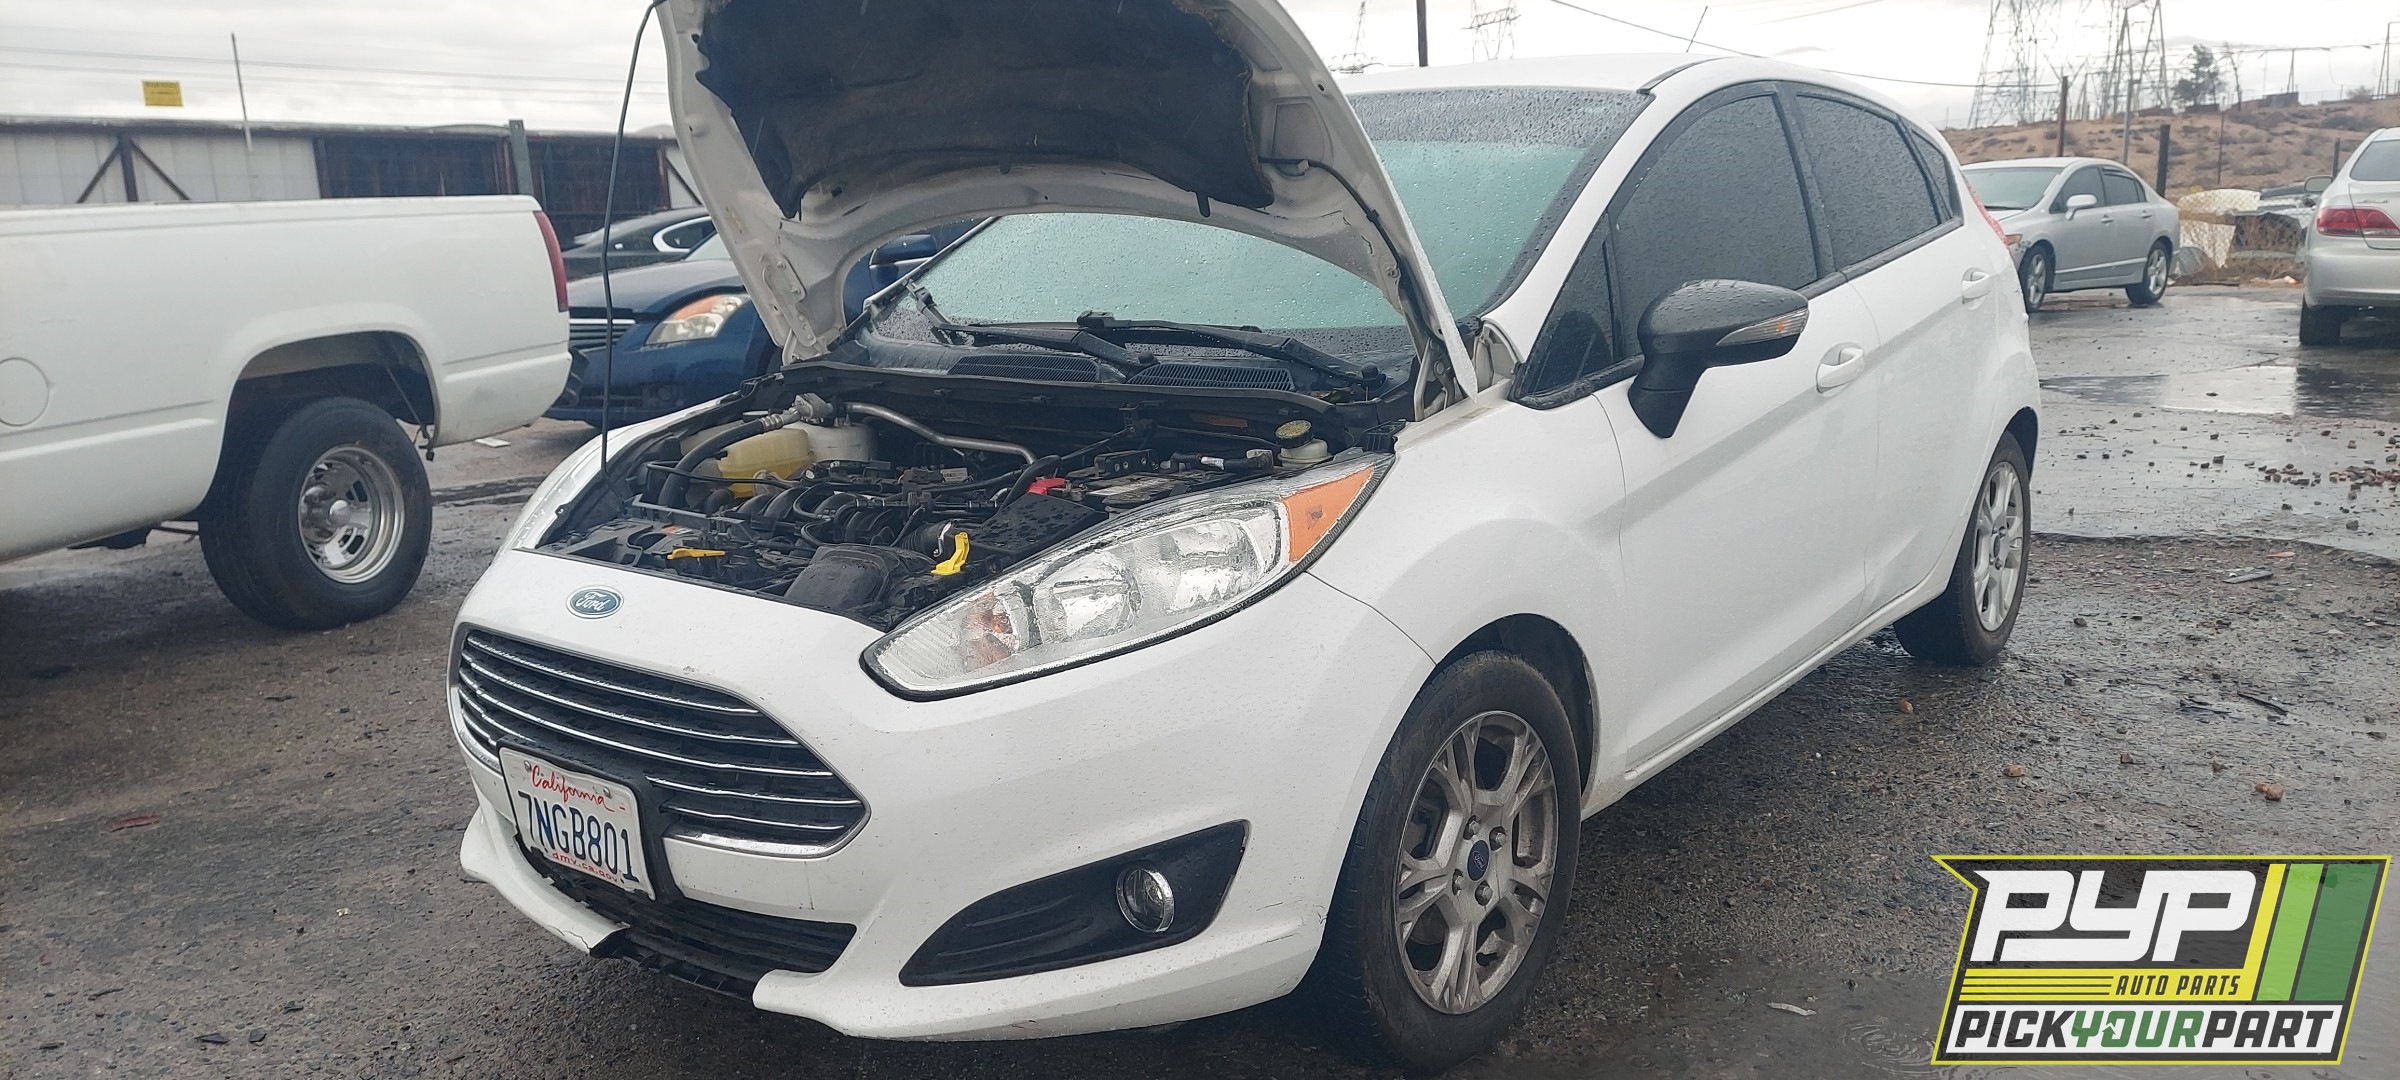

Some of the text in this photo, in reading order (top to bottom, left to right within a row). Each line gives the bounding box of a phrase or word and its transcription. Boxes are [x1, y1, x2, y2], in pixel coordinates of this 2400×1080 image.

[576, 591, 611, 611] Ford
[532, 765, 615, 812] California
[518, 790, 640, 883] 7NGB801
